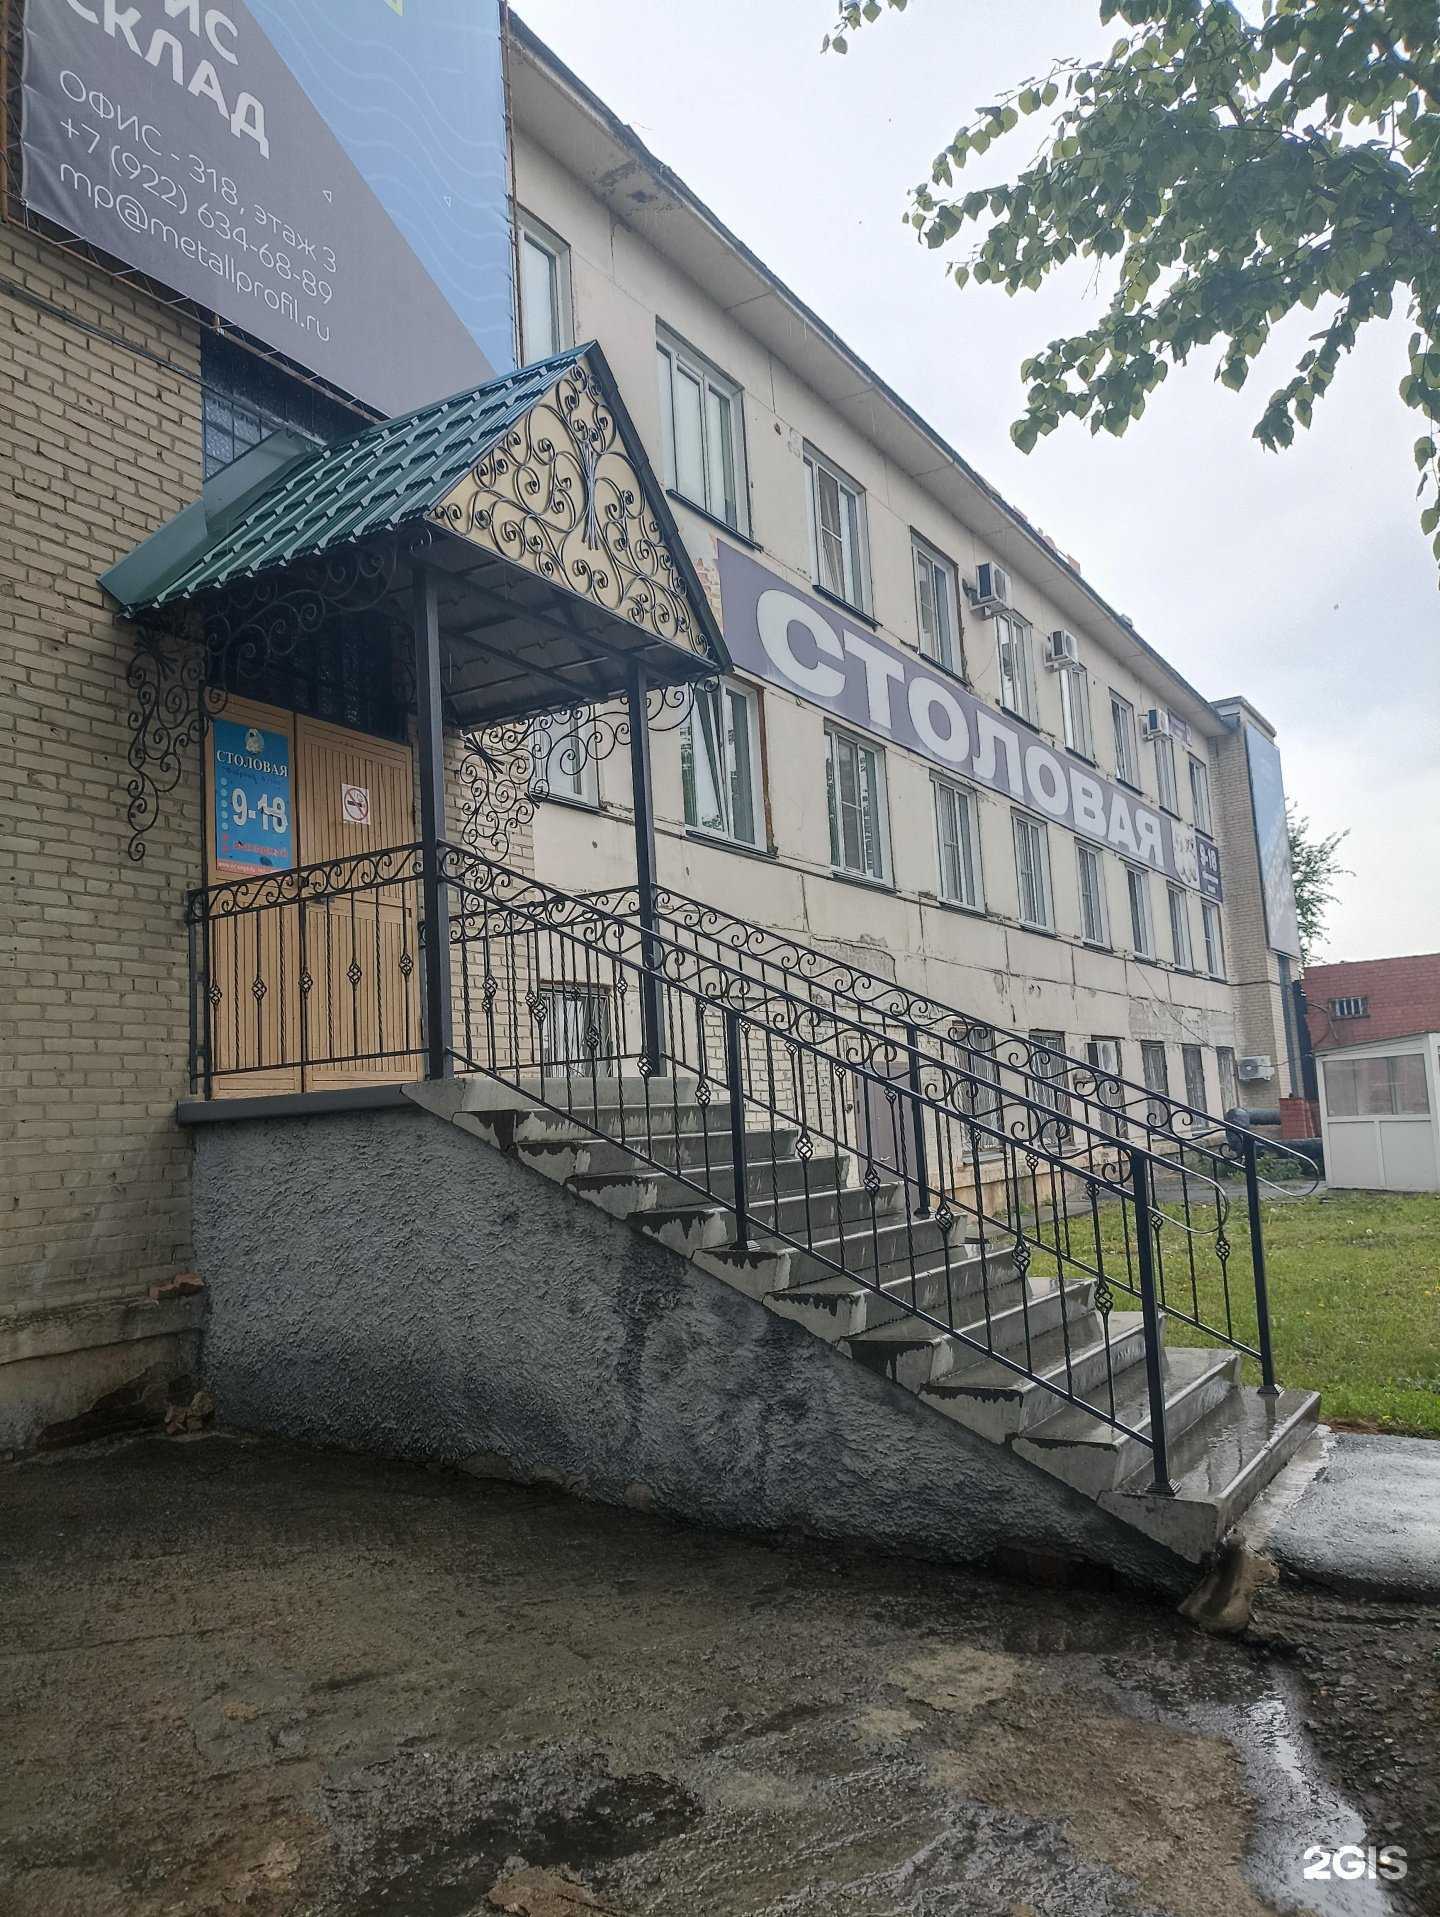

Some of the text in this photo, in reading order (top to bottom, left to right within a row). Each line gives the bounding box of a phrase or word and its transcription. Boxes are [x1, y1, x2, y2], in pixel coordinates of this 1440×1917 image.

[60, 70, 162, 156] ОФИС
[188, 153, 245, 216] 318,
[254, 204, 317, 261] этаж
[323, 246, 336, 272] 3
[60, 118, 333, 304] +7 (922) 634-68-89
[60, 163, 330, 342] mp@metallprofil.ru
[217, 750, 288, 777] СТОЛОВАЯ
[756, 588, 1165, 868] СТОЛОВАЯ
